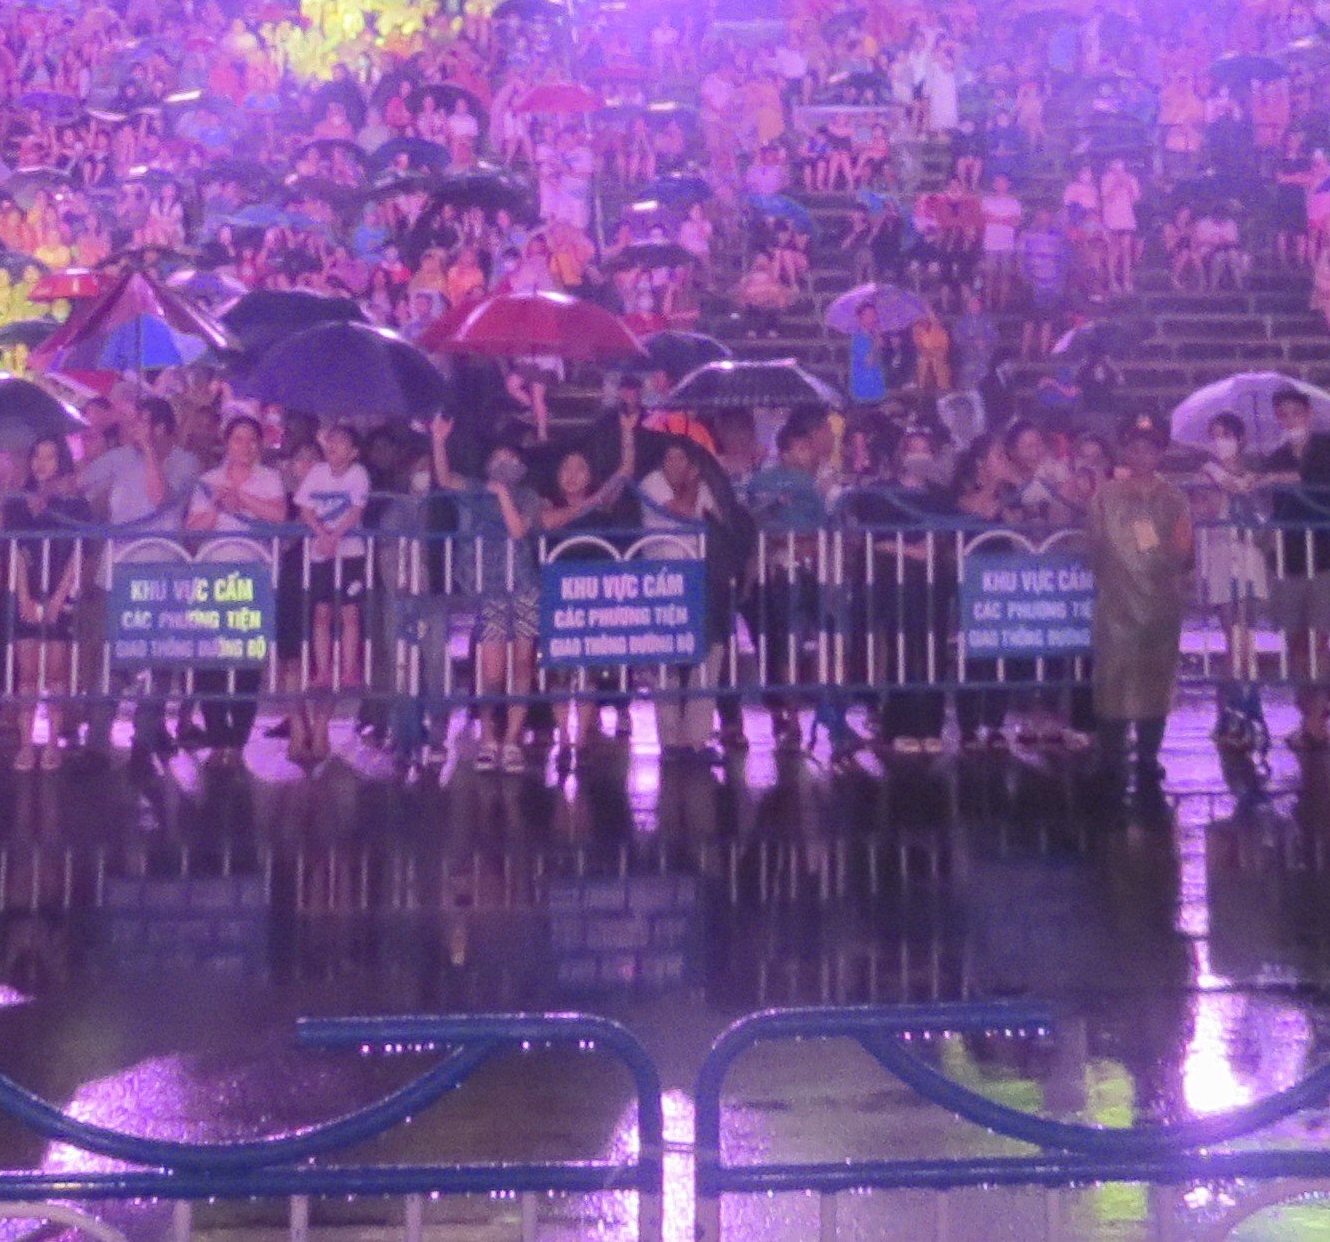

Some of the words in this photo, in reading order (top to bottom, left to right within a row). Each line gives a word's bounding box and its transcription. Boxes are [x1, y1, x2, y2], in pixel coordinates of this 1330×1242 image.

[131, 580, 167, 601] KHU
[214, 571, 254, 601] CẤM
[561, 577, 598, 599] KHU
[644, 567, 684, 597] CẤM
[983, 571, 1017, 591] KHU
[554, 606, 585, 628] CÁC
